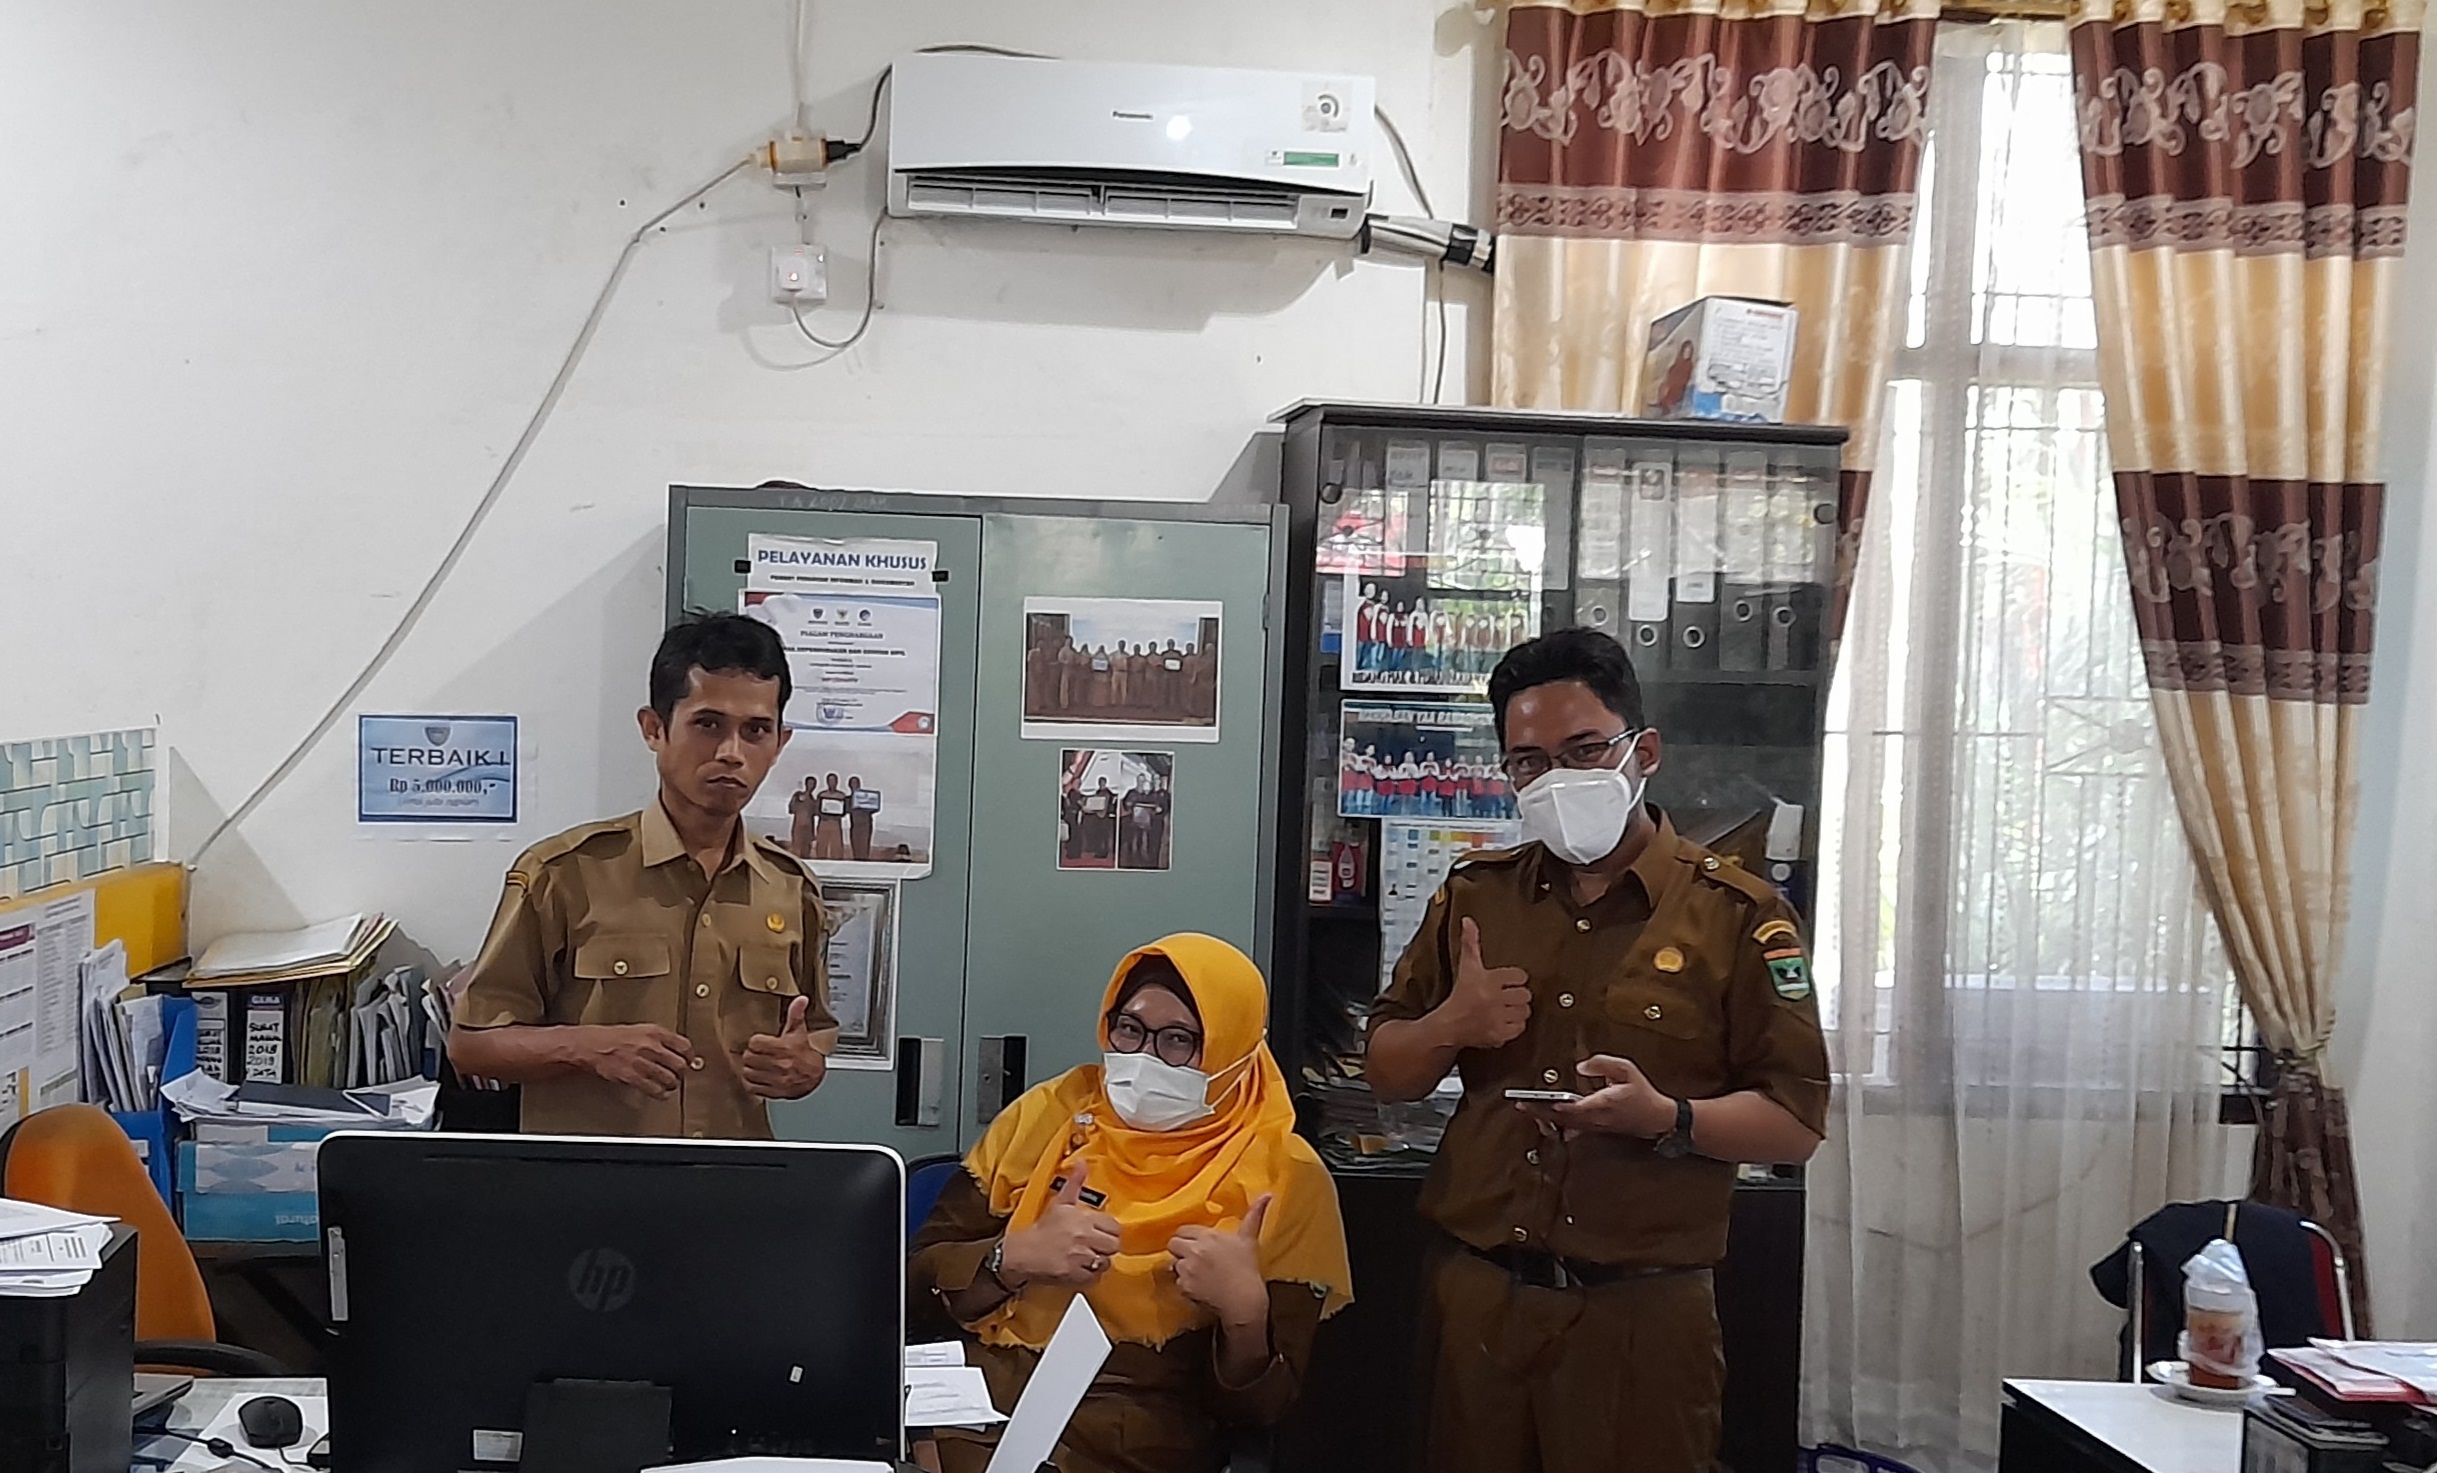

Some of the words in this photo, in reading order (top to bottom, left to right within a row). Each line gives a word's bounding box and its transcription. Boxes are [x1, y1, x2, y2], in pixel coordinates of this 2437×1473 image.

[757, 550, 860, 567] PELAYANAN
[865, 554, 927, 570] KHUSUS
[371, 747, 491, 766] TERBAIK
[390, 778, 408, 794] Rp
[576, 1247, 632, 1312] hp
